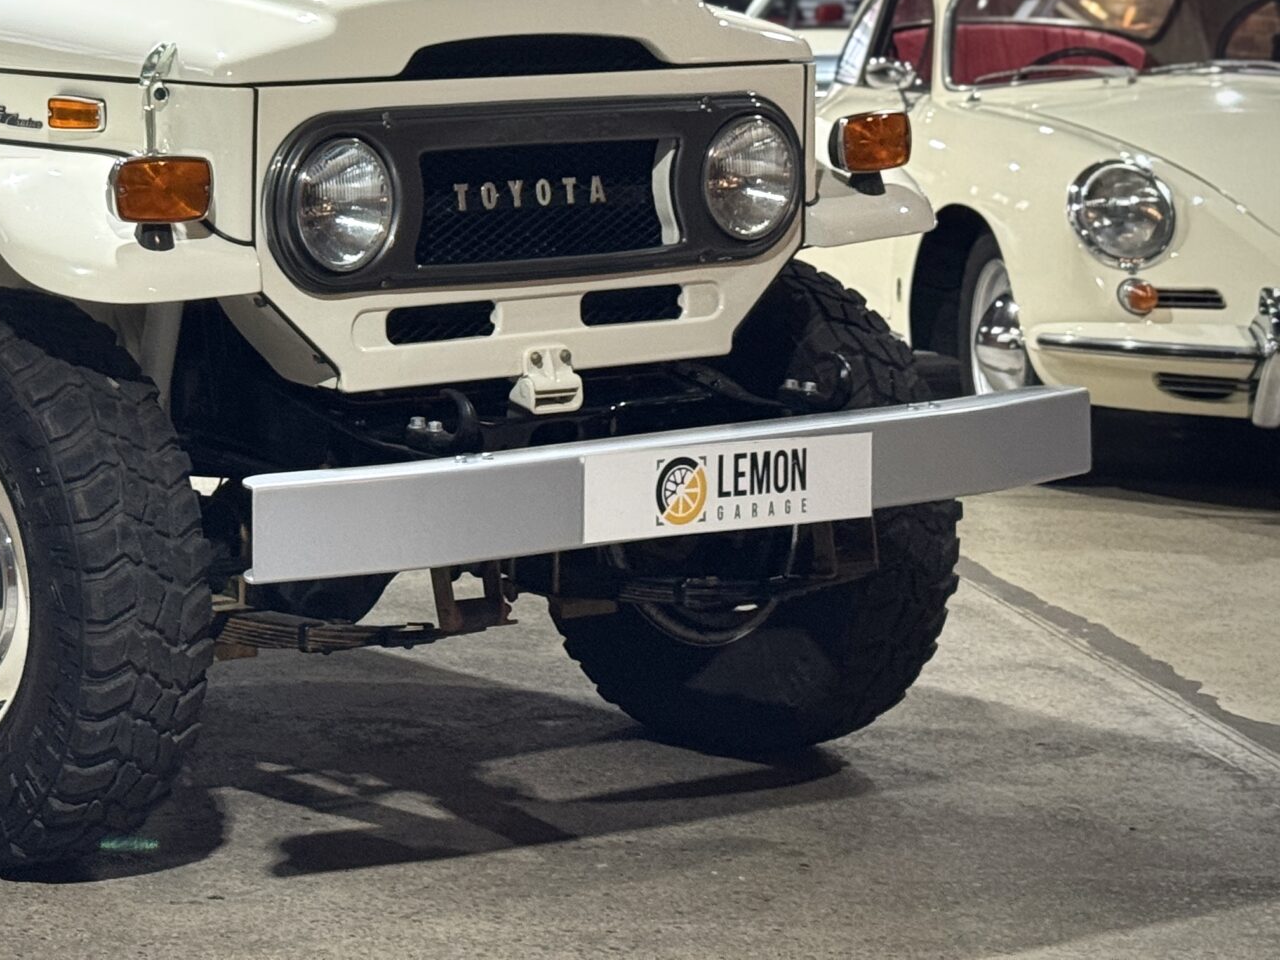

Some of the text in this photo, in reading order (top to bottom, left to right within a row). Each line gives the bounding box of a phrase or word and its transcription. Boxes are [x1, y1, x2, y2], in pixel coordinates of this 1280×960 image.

[453, 175, 607, 212] TOYOTA
[717, 448, 808, 498] LEMON
[717, 498, 808, 521] GARAGE
